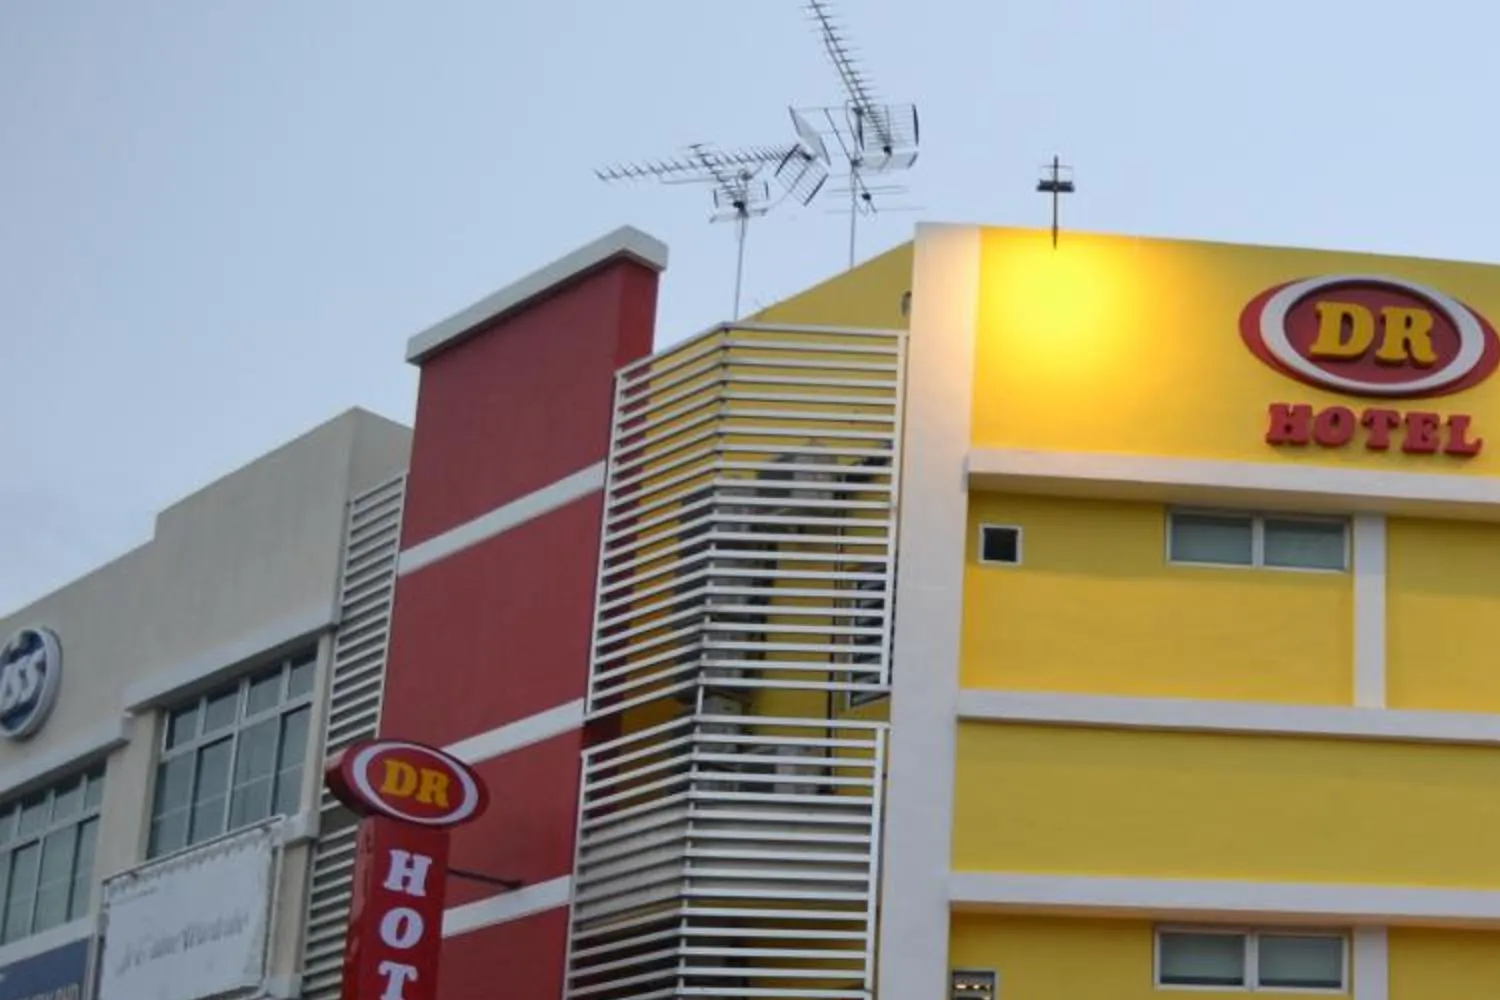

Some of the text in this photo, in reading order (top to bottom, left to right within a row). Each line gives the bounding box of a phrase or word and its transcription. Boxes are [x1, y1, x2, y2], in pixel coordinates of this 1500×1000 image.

[1310, 302, 1437, 367] DR
[1265, 403, 1483, 456] HOTEL
[381, 759, 450, 808] DR
